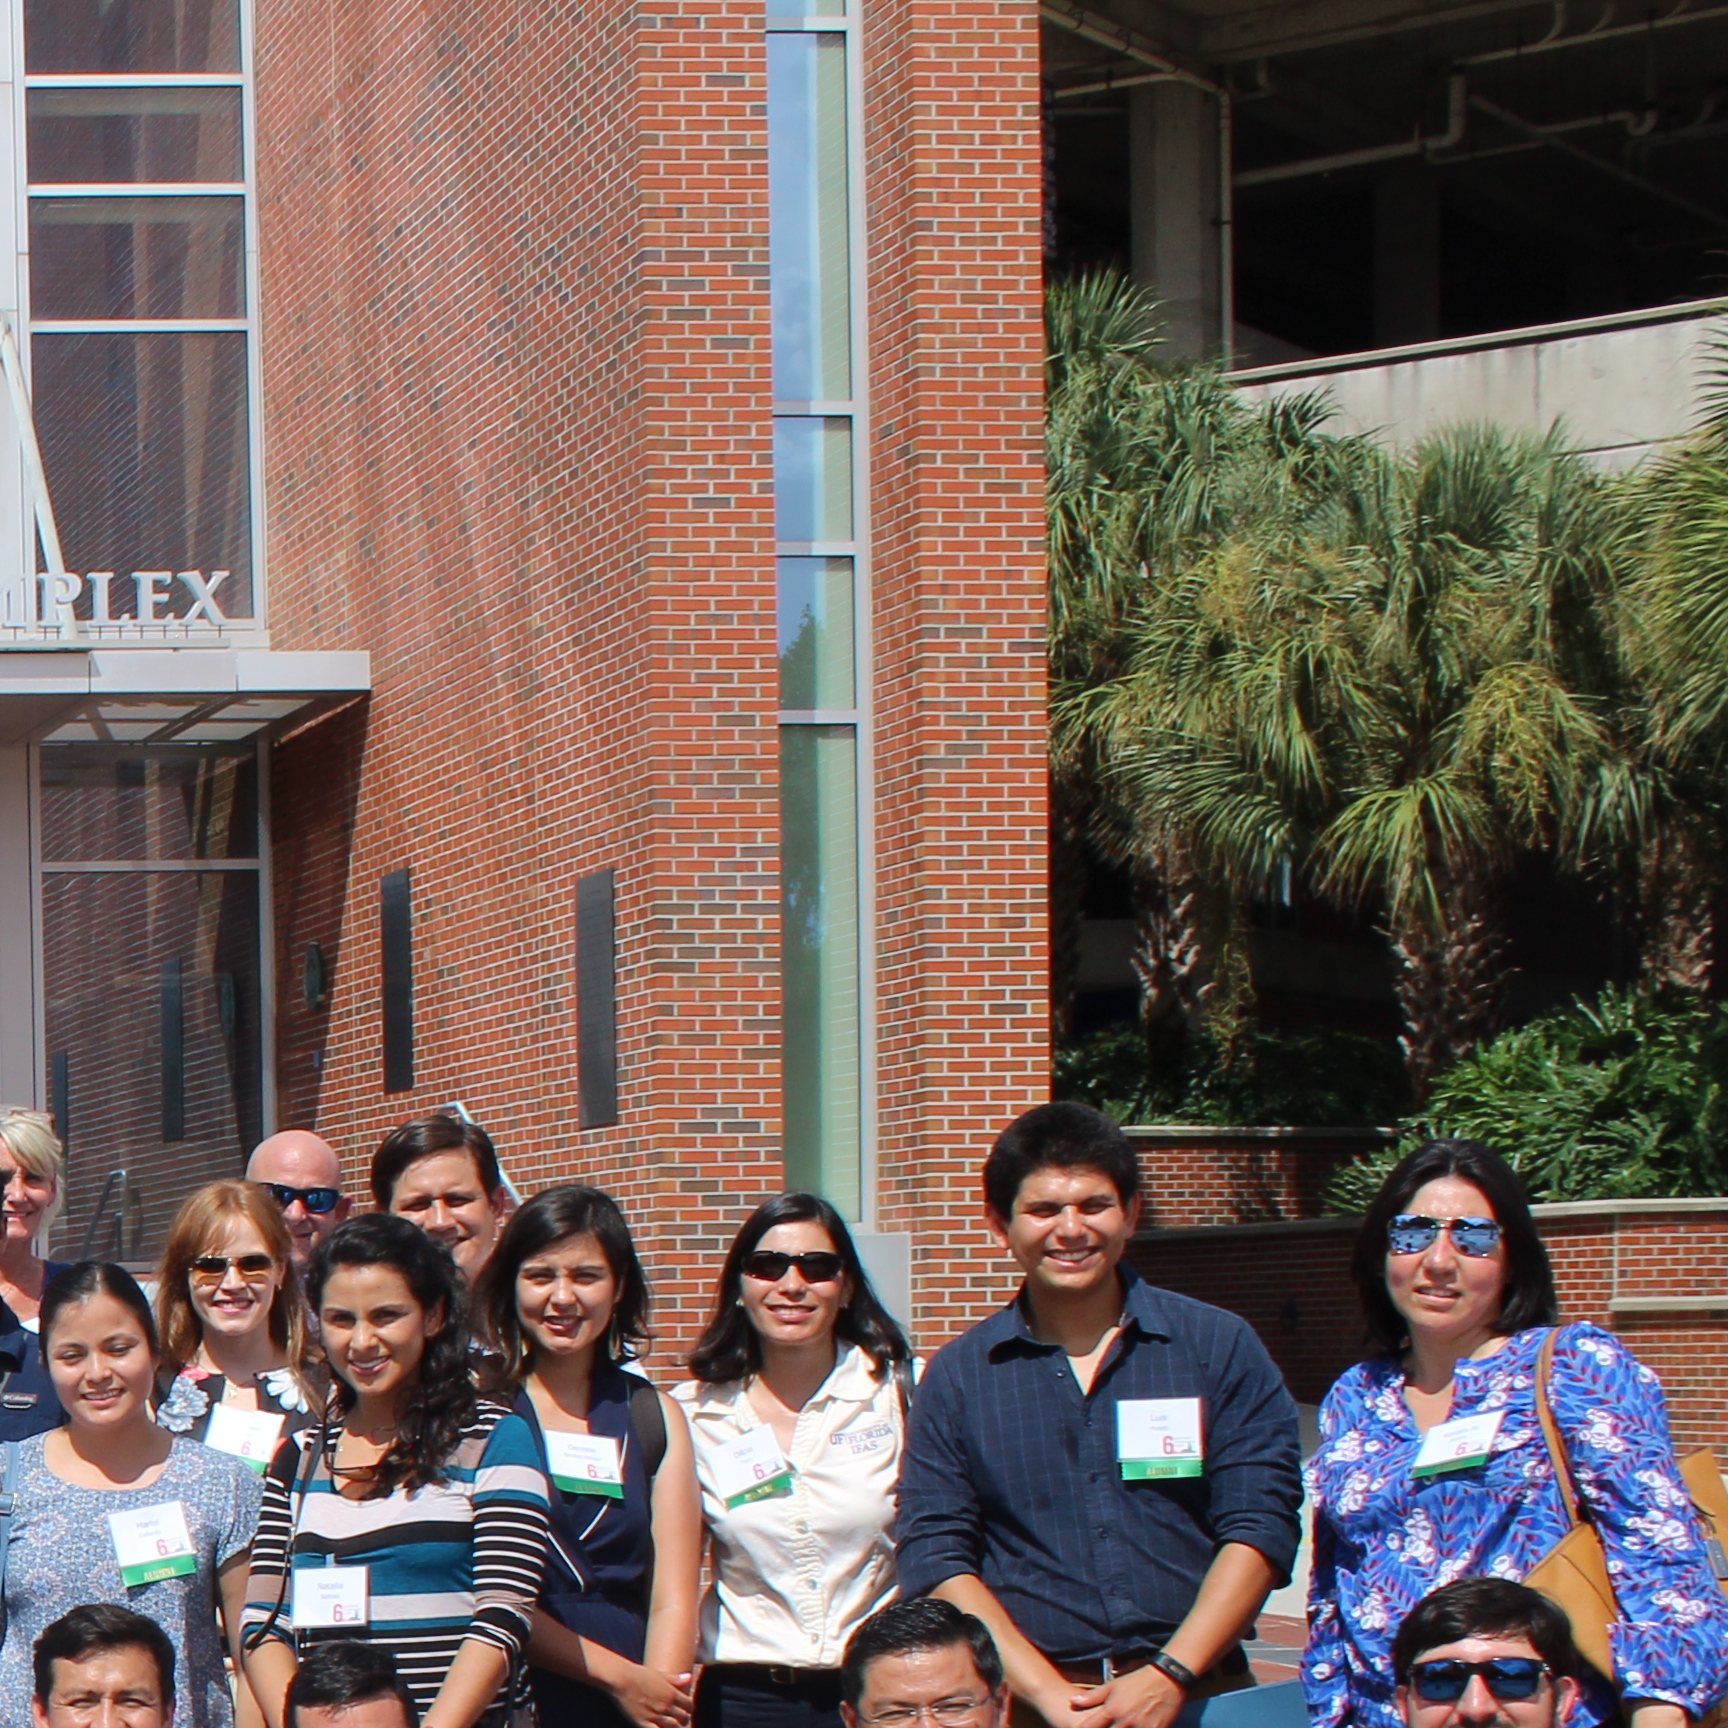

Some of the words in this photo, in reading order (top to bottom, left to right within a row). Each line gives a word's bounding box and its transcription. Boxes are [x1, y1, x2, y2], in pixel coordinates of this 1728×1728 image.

[830, 1433, 844, 1445] UF
[847, 1425, 894, 1444] FLORIDA
[851, 1441, 878, 1454] IFAS
